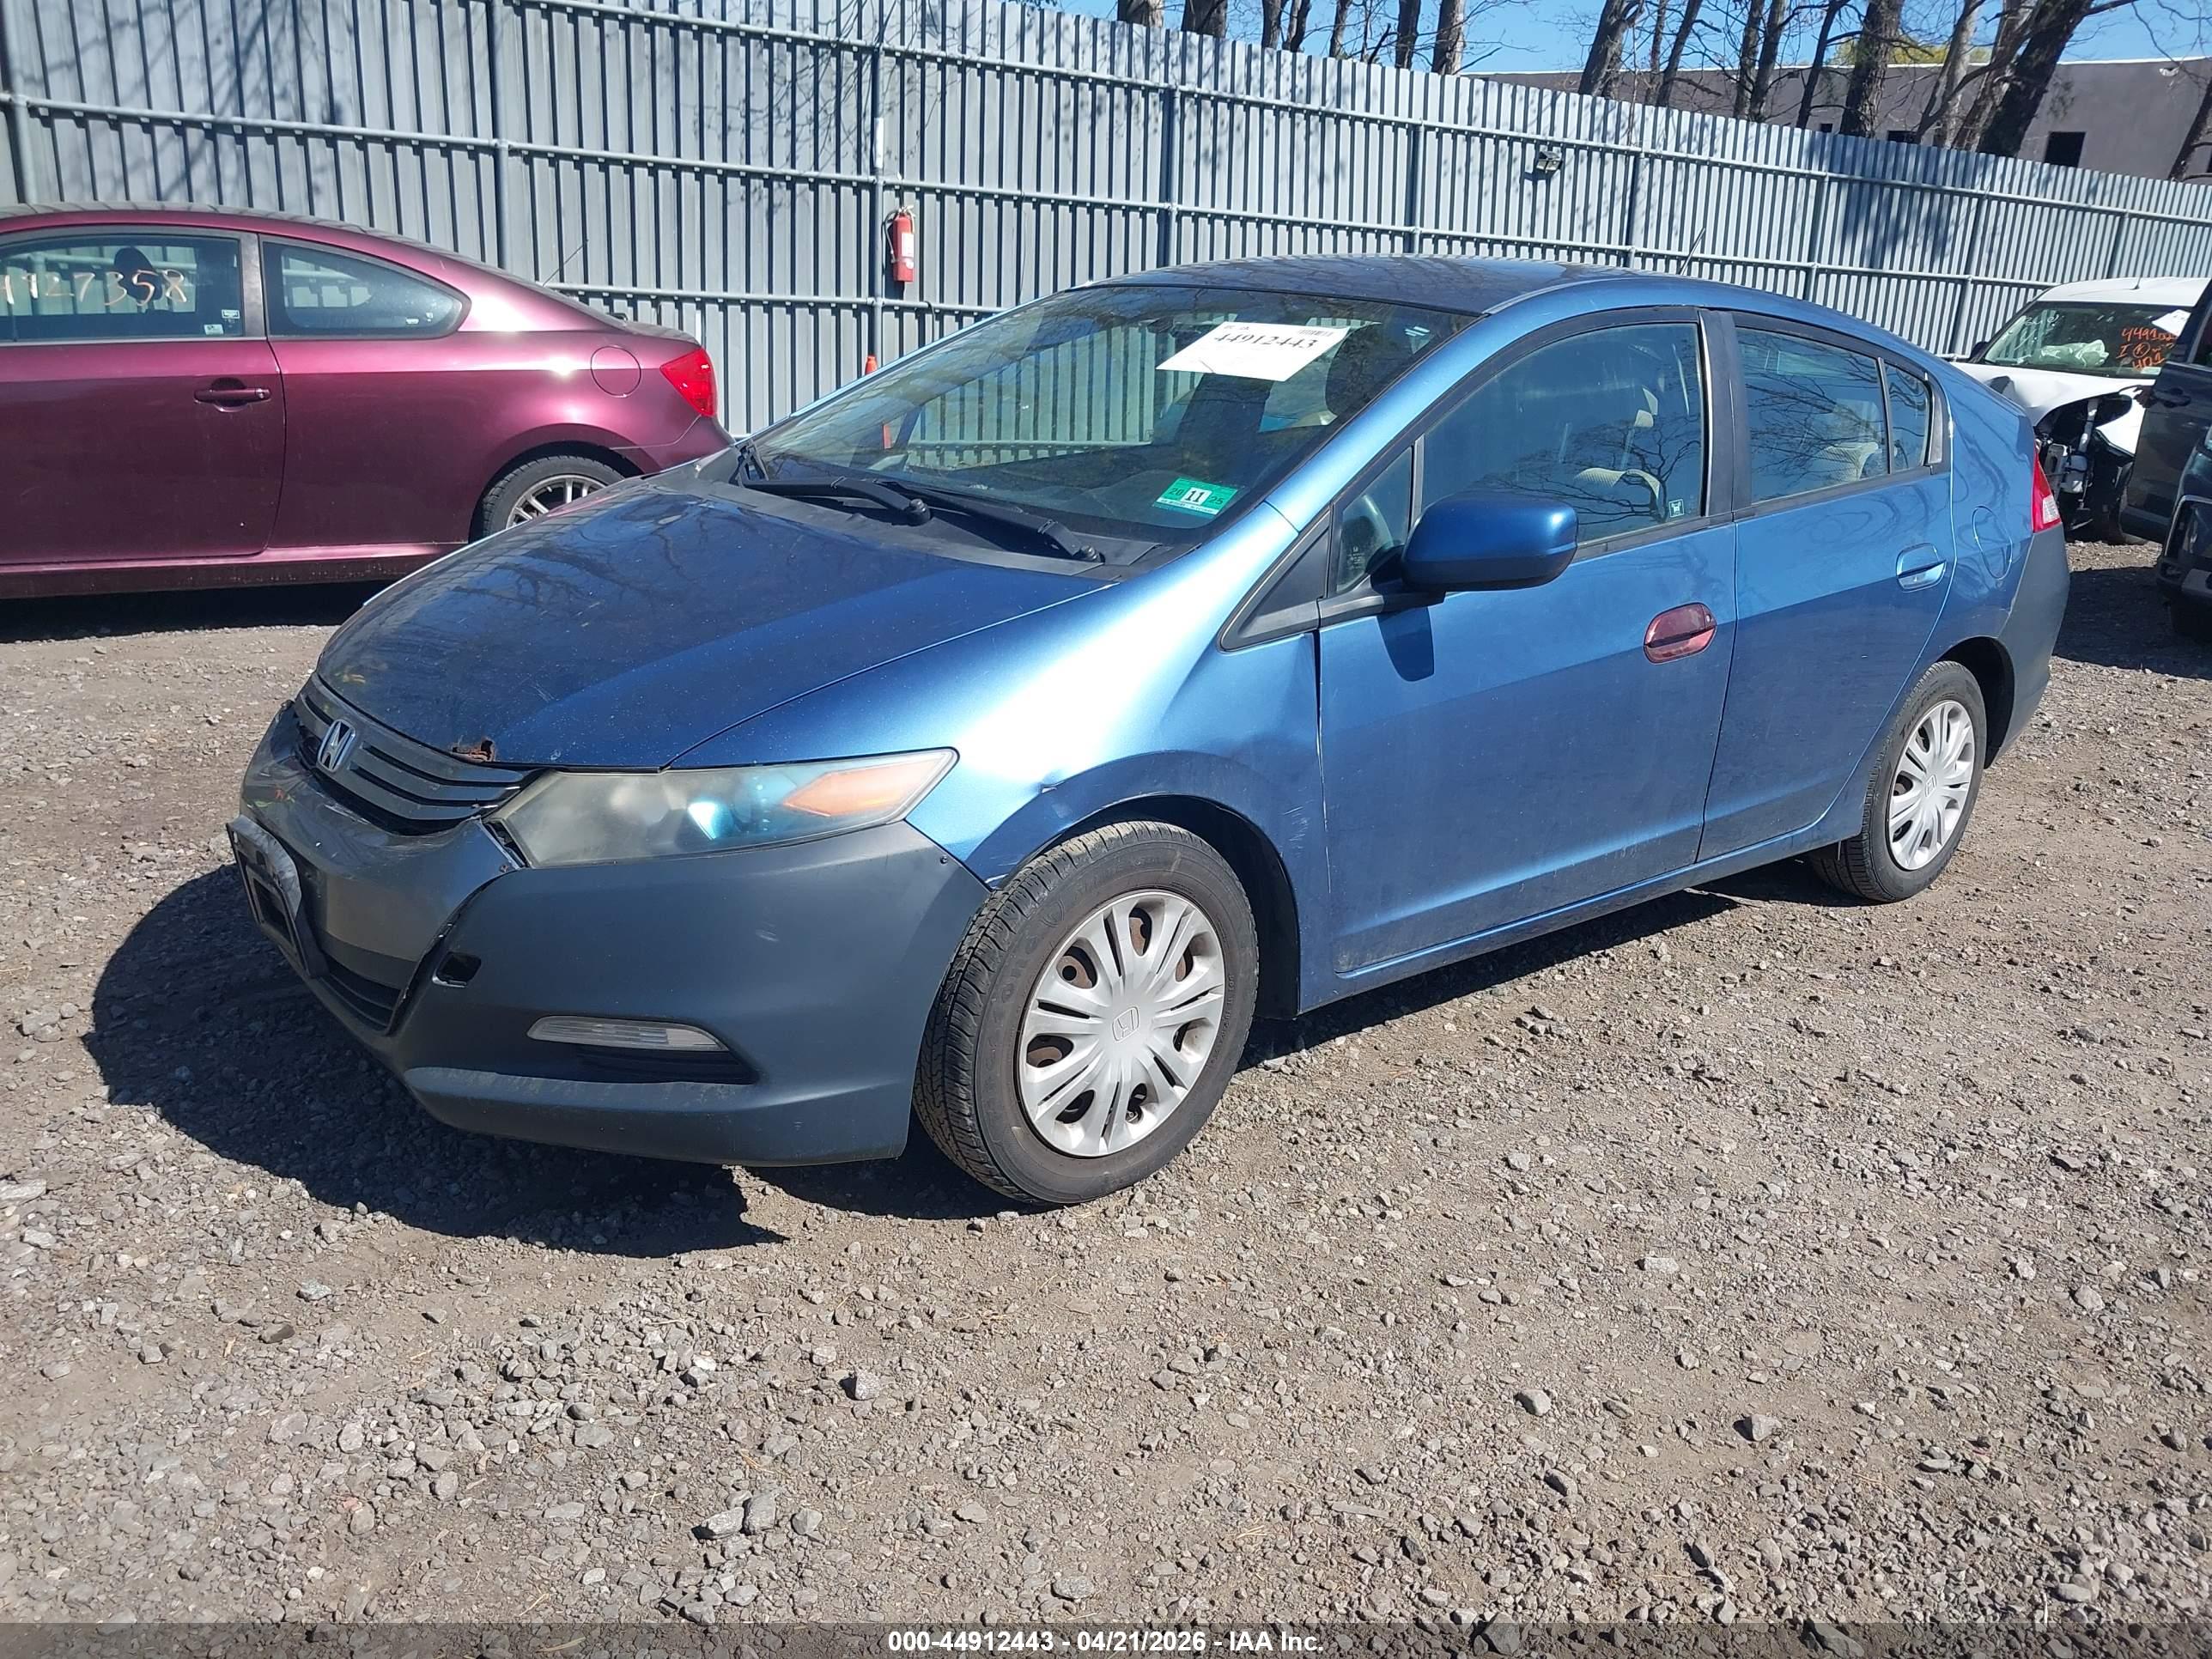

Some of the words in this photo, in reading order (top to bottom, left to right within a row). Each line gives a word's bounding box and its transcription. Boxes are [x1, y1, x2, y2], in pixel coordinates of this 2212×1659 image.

[1214, 333, 1319, 349] 44912443
[1185, 489, 1205, 503] 11
[1208, 496, 1224, 505] 25
